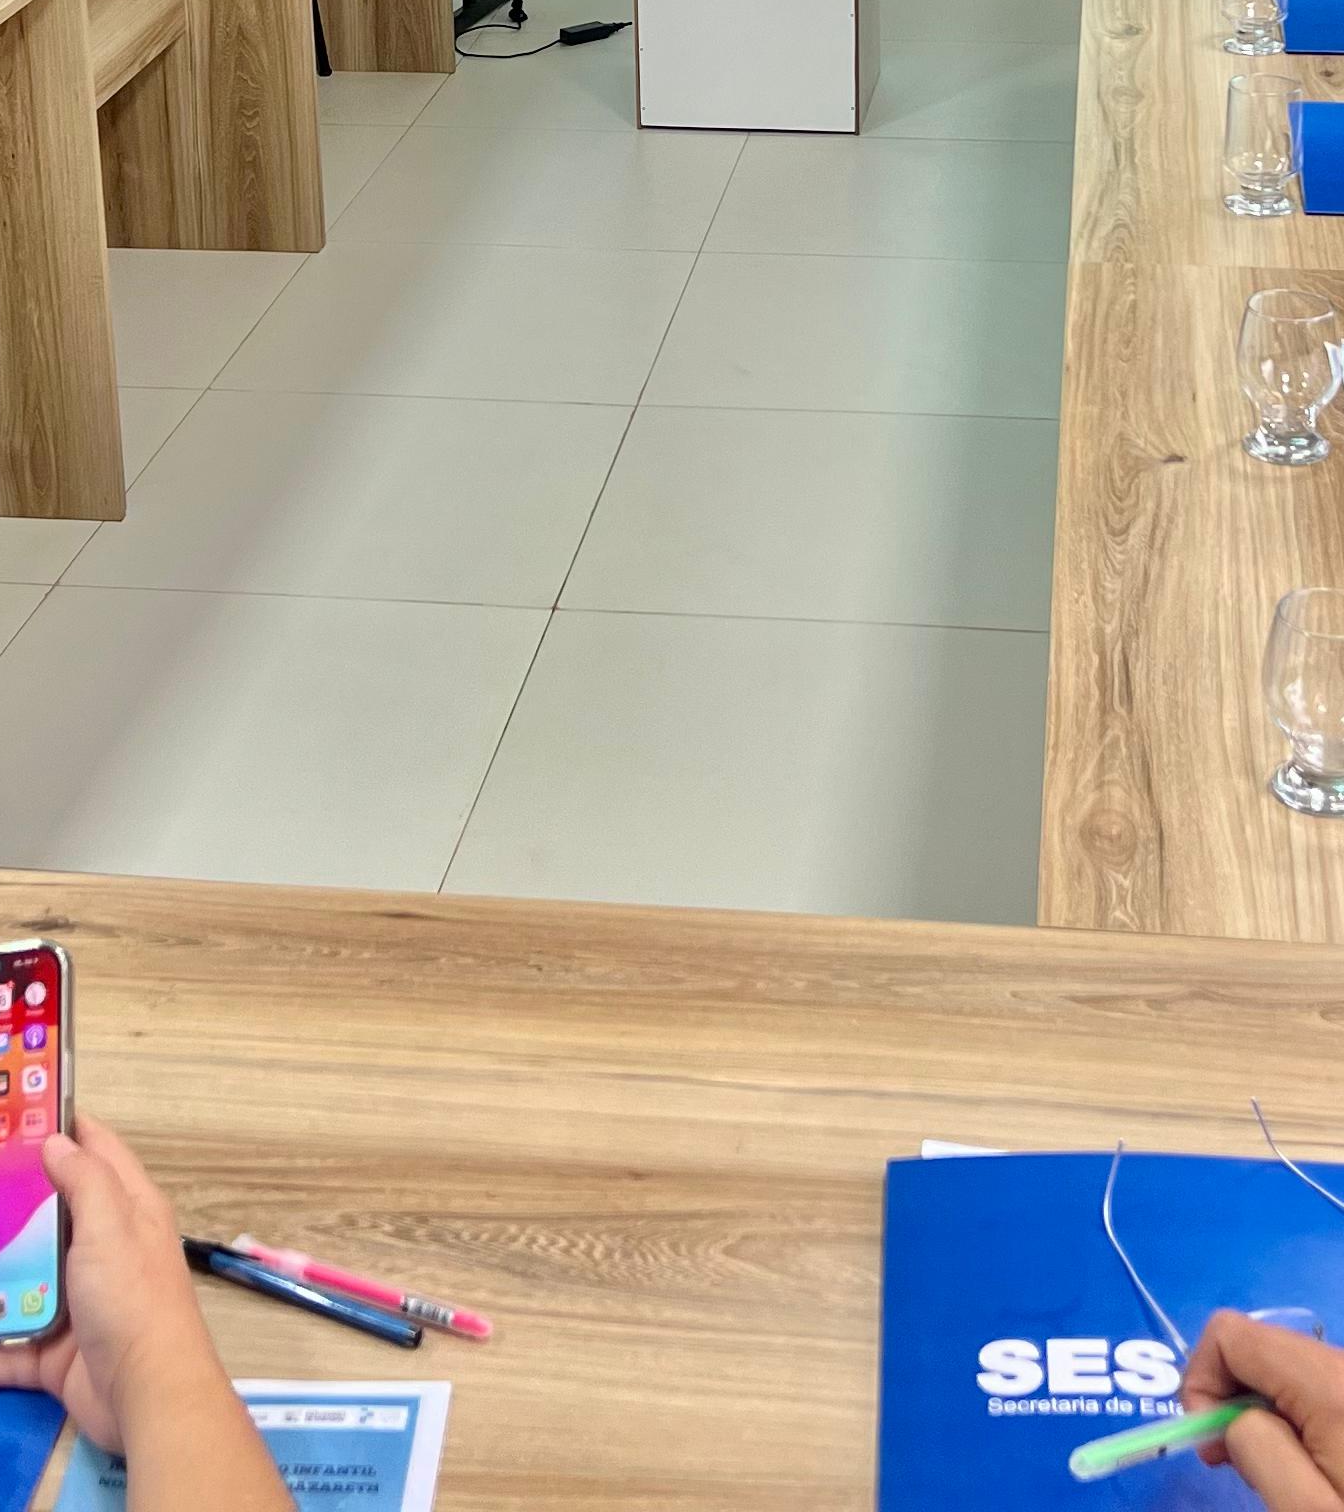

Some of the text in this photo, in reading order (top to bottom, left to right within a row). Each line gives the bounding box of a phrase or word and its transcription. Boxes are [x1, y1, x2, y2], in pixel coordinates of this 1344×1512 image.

[976, 1338, 1184, 1397] SES
[987, 1396, 1185, 1416] Secretaria de Esta
[287, 1480, 379, 1494] AZARETH
